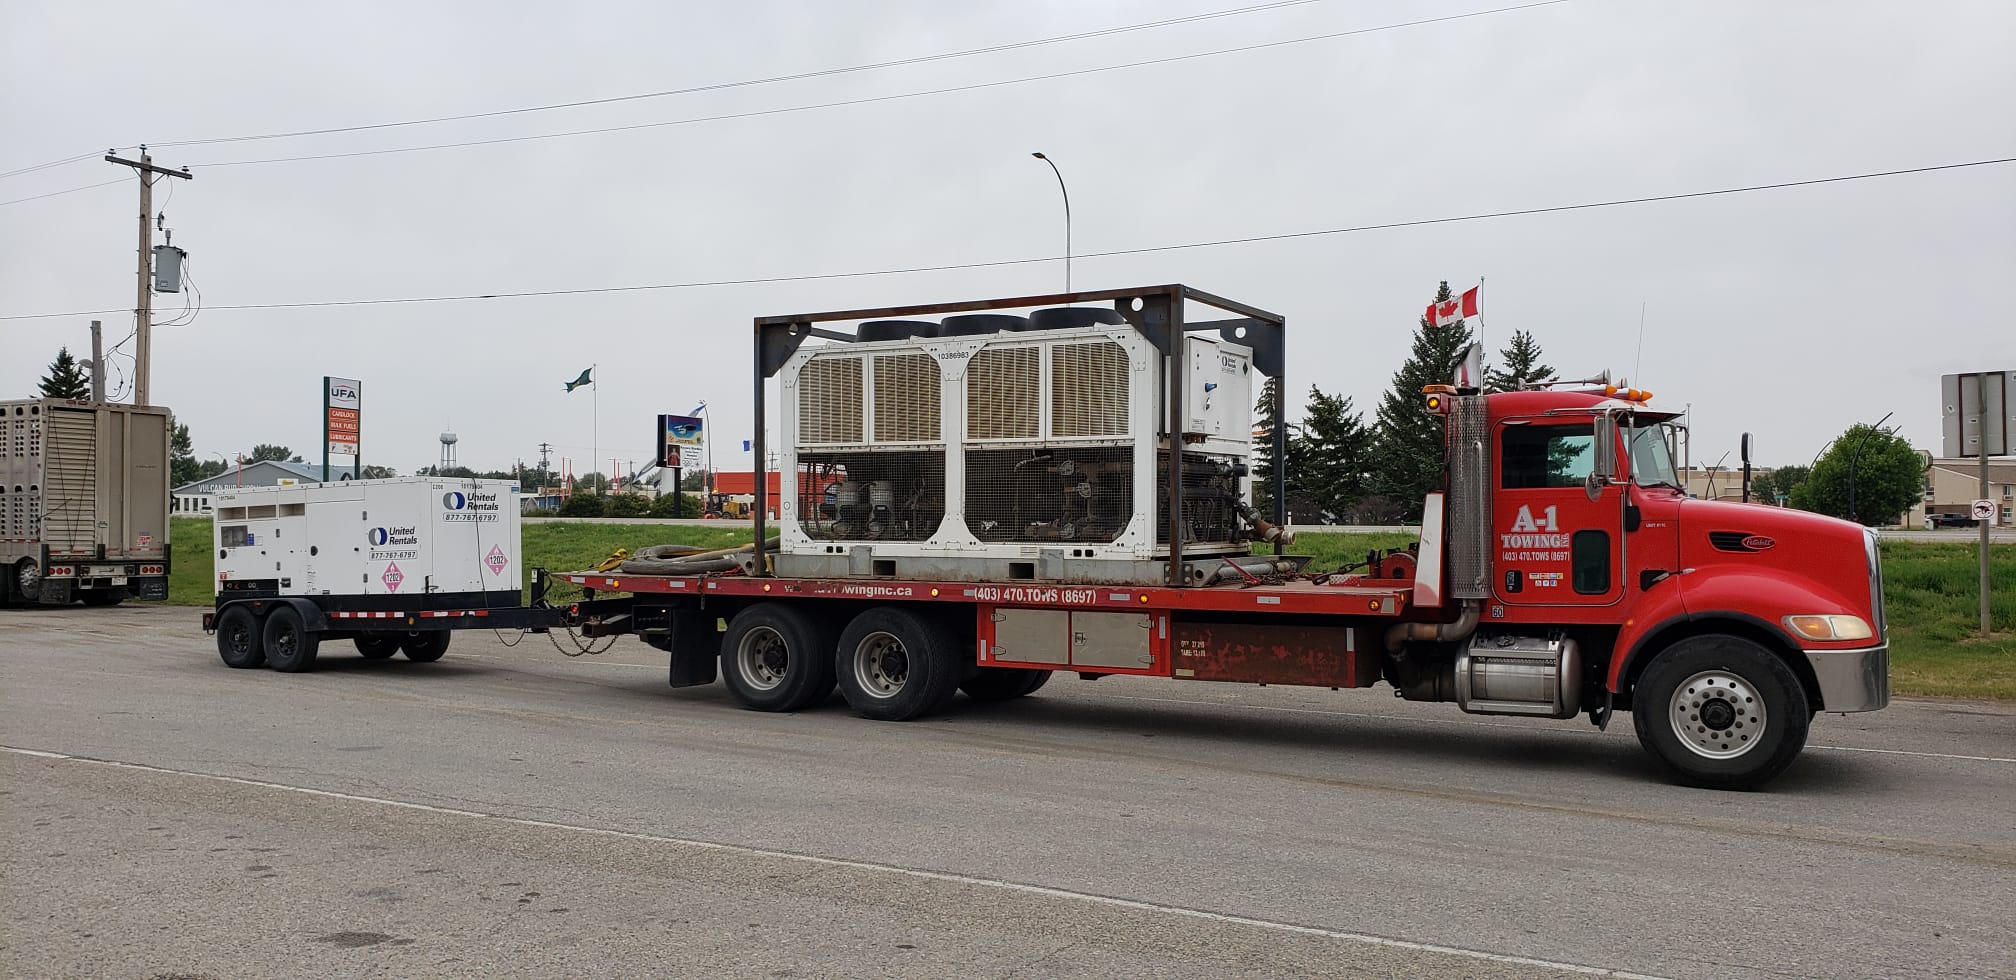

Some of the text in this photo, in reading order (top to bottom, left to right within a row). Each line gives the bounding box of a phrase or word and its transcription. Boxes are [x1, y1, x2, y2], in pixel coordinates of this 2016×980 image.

[331, 387, 357, 400] UFA
[329, 433, 357, 442] LUBRICANTS
[467, 492, 497, 502] United
[466, 501, 499, 511] Rentals
[1510, 503, 1560, 533] A-1
[389, 525, 416, 536] United
[388, 535, 418, 545] Rentals
[1501, 533, 1561, 549] TOWING
[371, 551, 416, 560] 877-767-6797
[490, 555, 504, 565] 1202
[1502, 551, 1570, 562] (403) 470.TOWS (8697)
[386, 573, 400, 582] 1202
[974, 587, 1097, 604] (403) 470.TOWS (8697)
